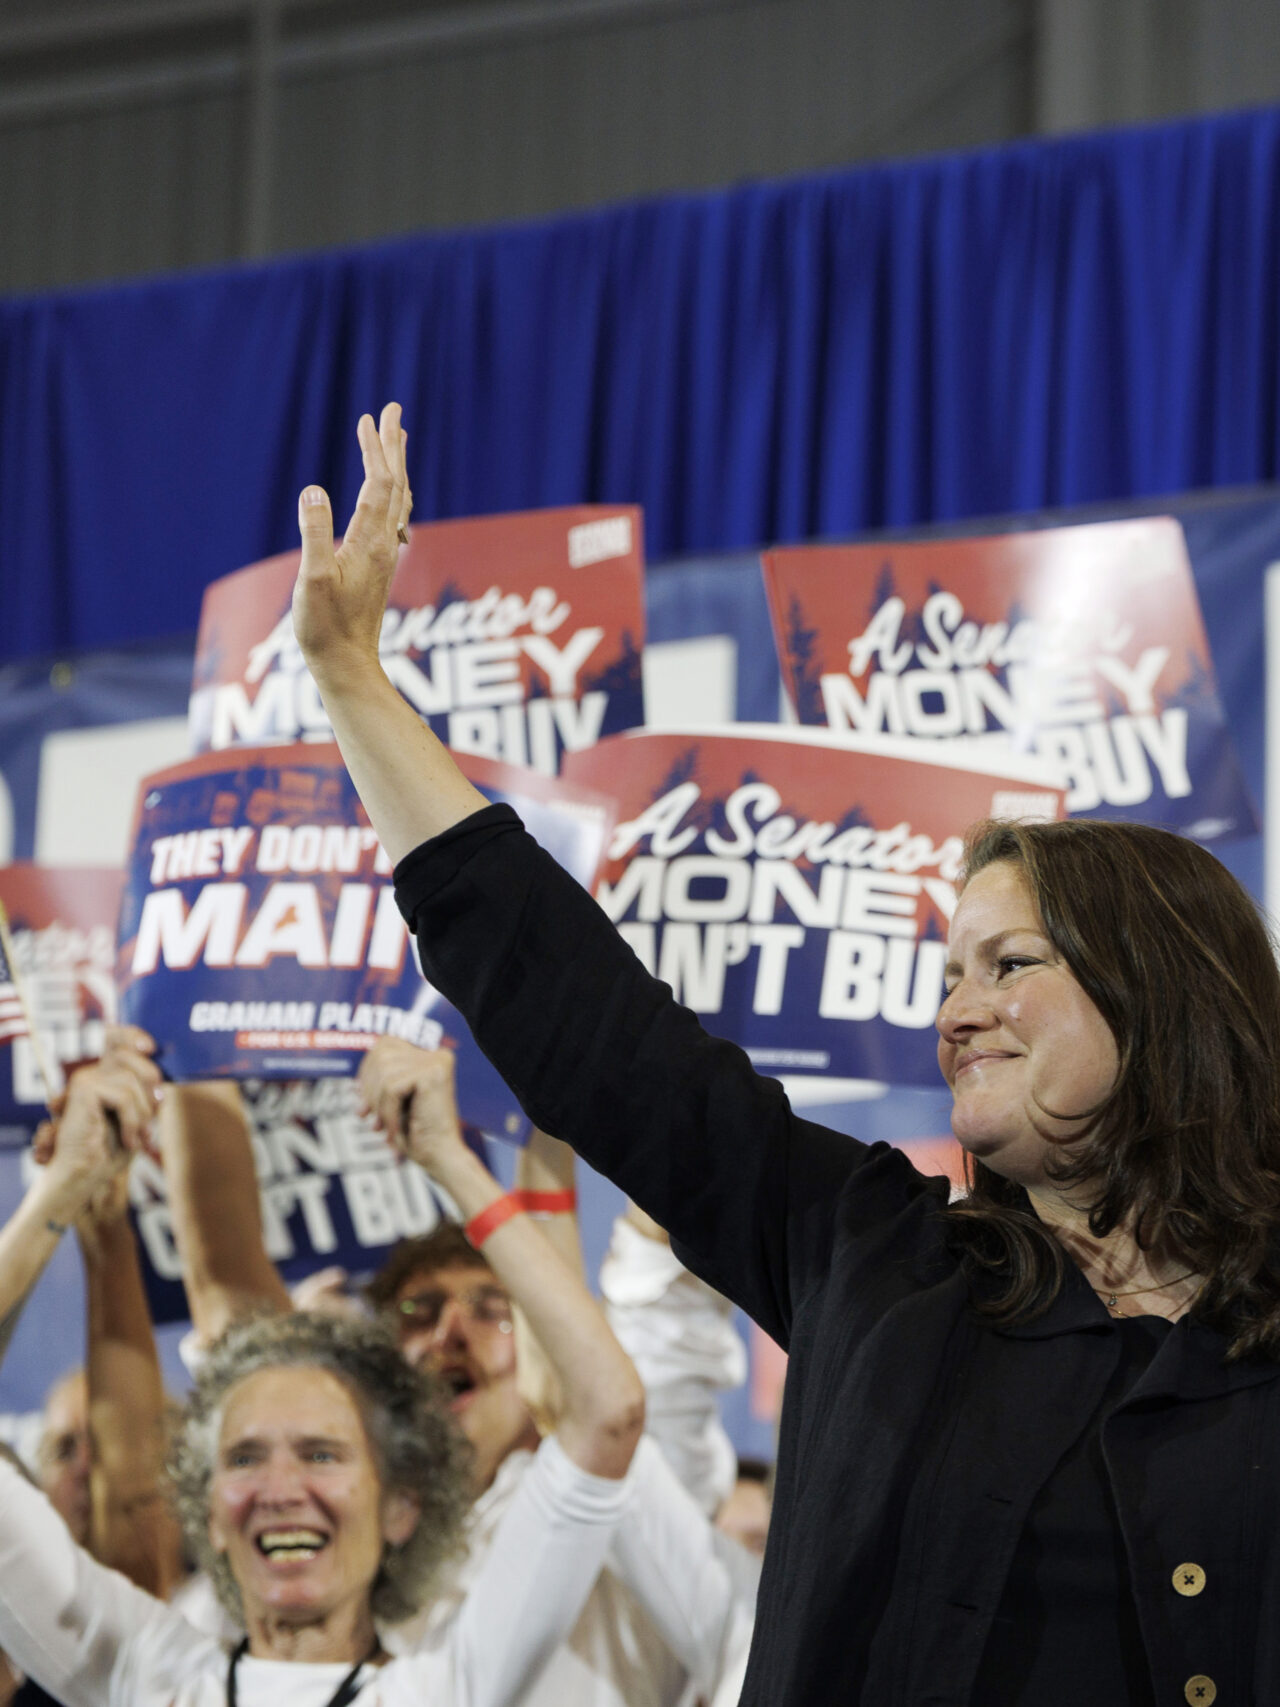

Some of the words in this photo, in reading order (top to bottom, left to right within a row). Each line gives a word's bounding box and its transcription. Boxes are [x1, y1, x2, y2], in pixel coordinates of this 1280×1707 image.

[848, 597, 915, 677] A
[149, 826, 254, 885] THEY
[607, 782, 700, 859] A
[598, 855, 966, 938] MONE
[189, 1001, 316, 1032] GRAHAM
[818, 928, 950, 1030] BU
